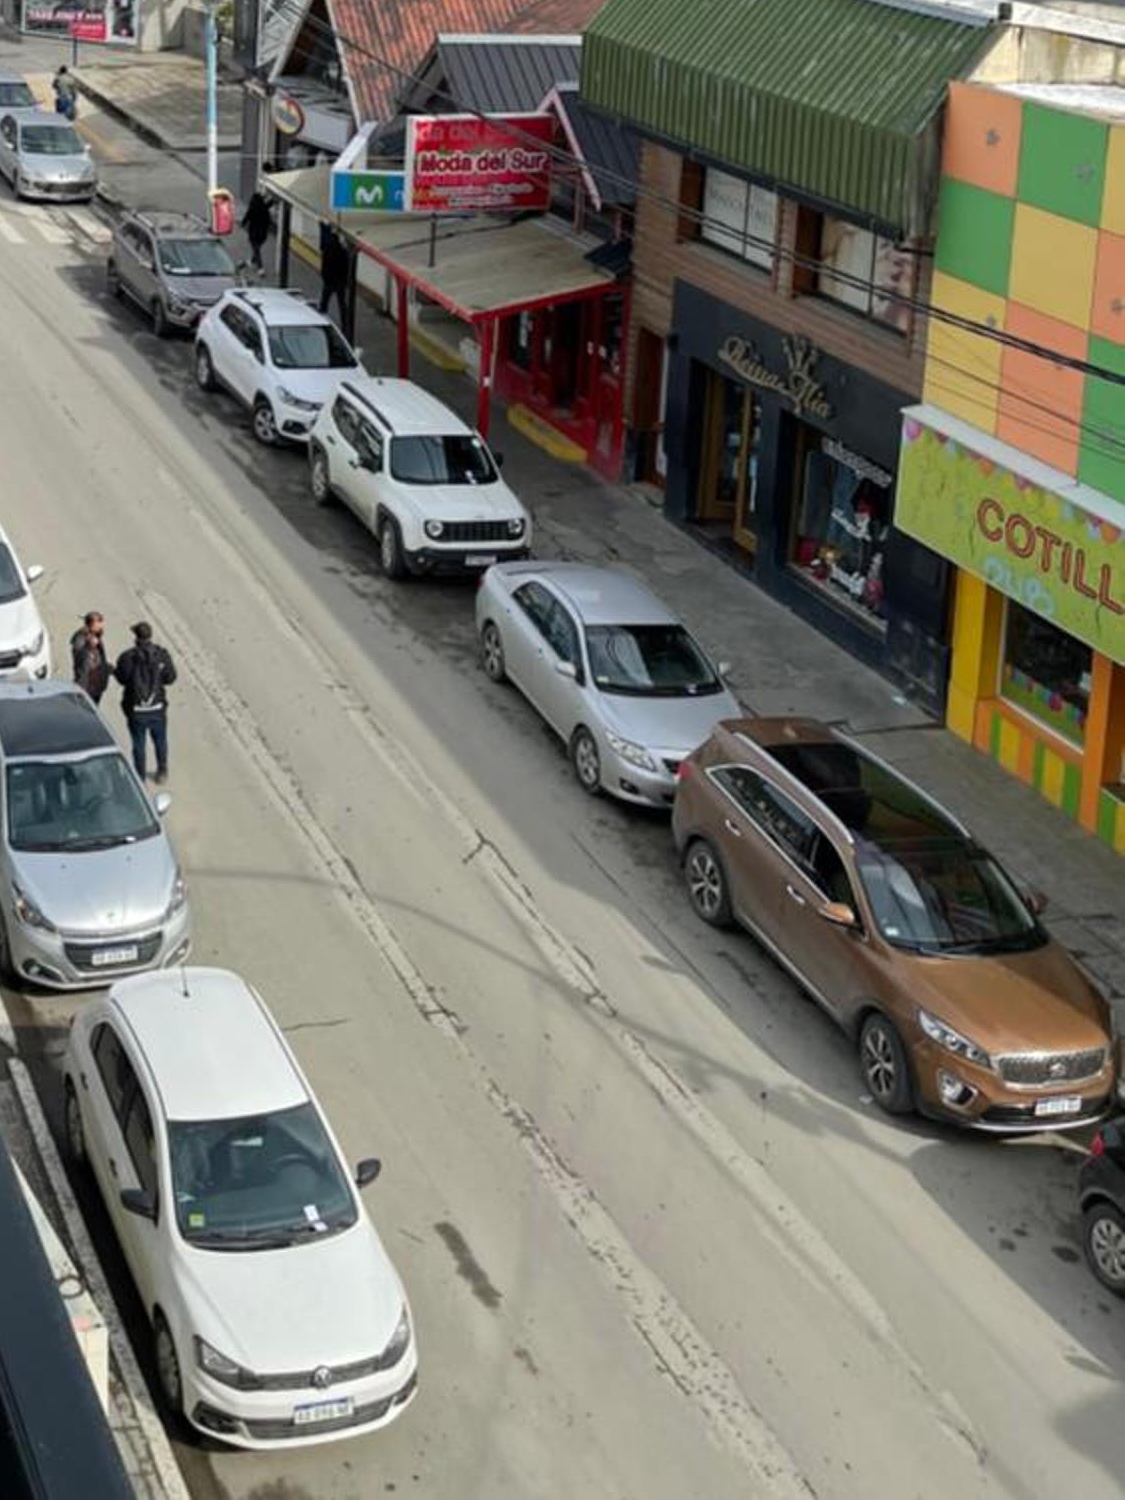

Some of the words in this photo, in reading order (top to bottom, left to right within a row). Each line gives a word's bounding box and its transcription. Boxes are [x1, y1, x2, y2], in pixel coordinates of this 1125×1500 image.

[418, 151, 474, 174] Moda
[476, 148, 507, 174] del
[510, 147, 547, 172] Sur
[977, 498, 1125, 615] COTILL
